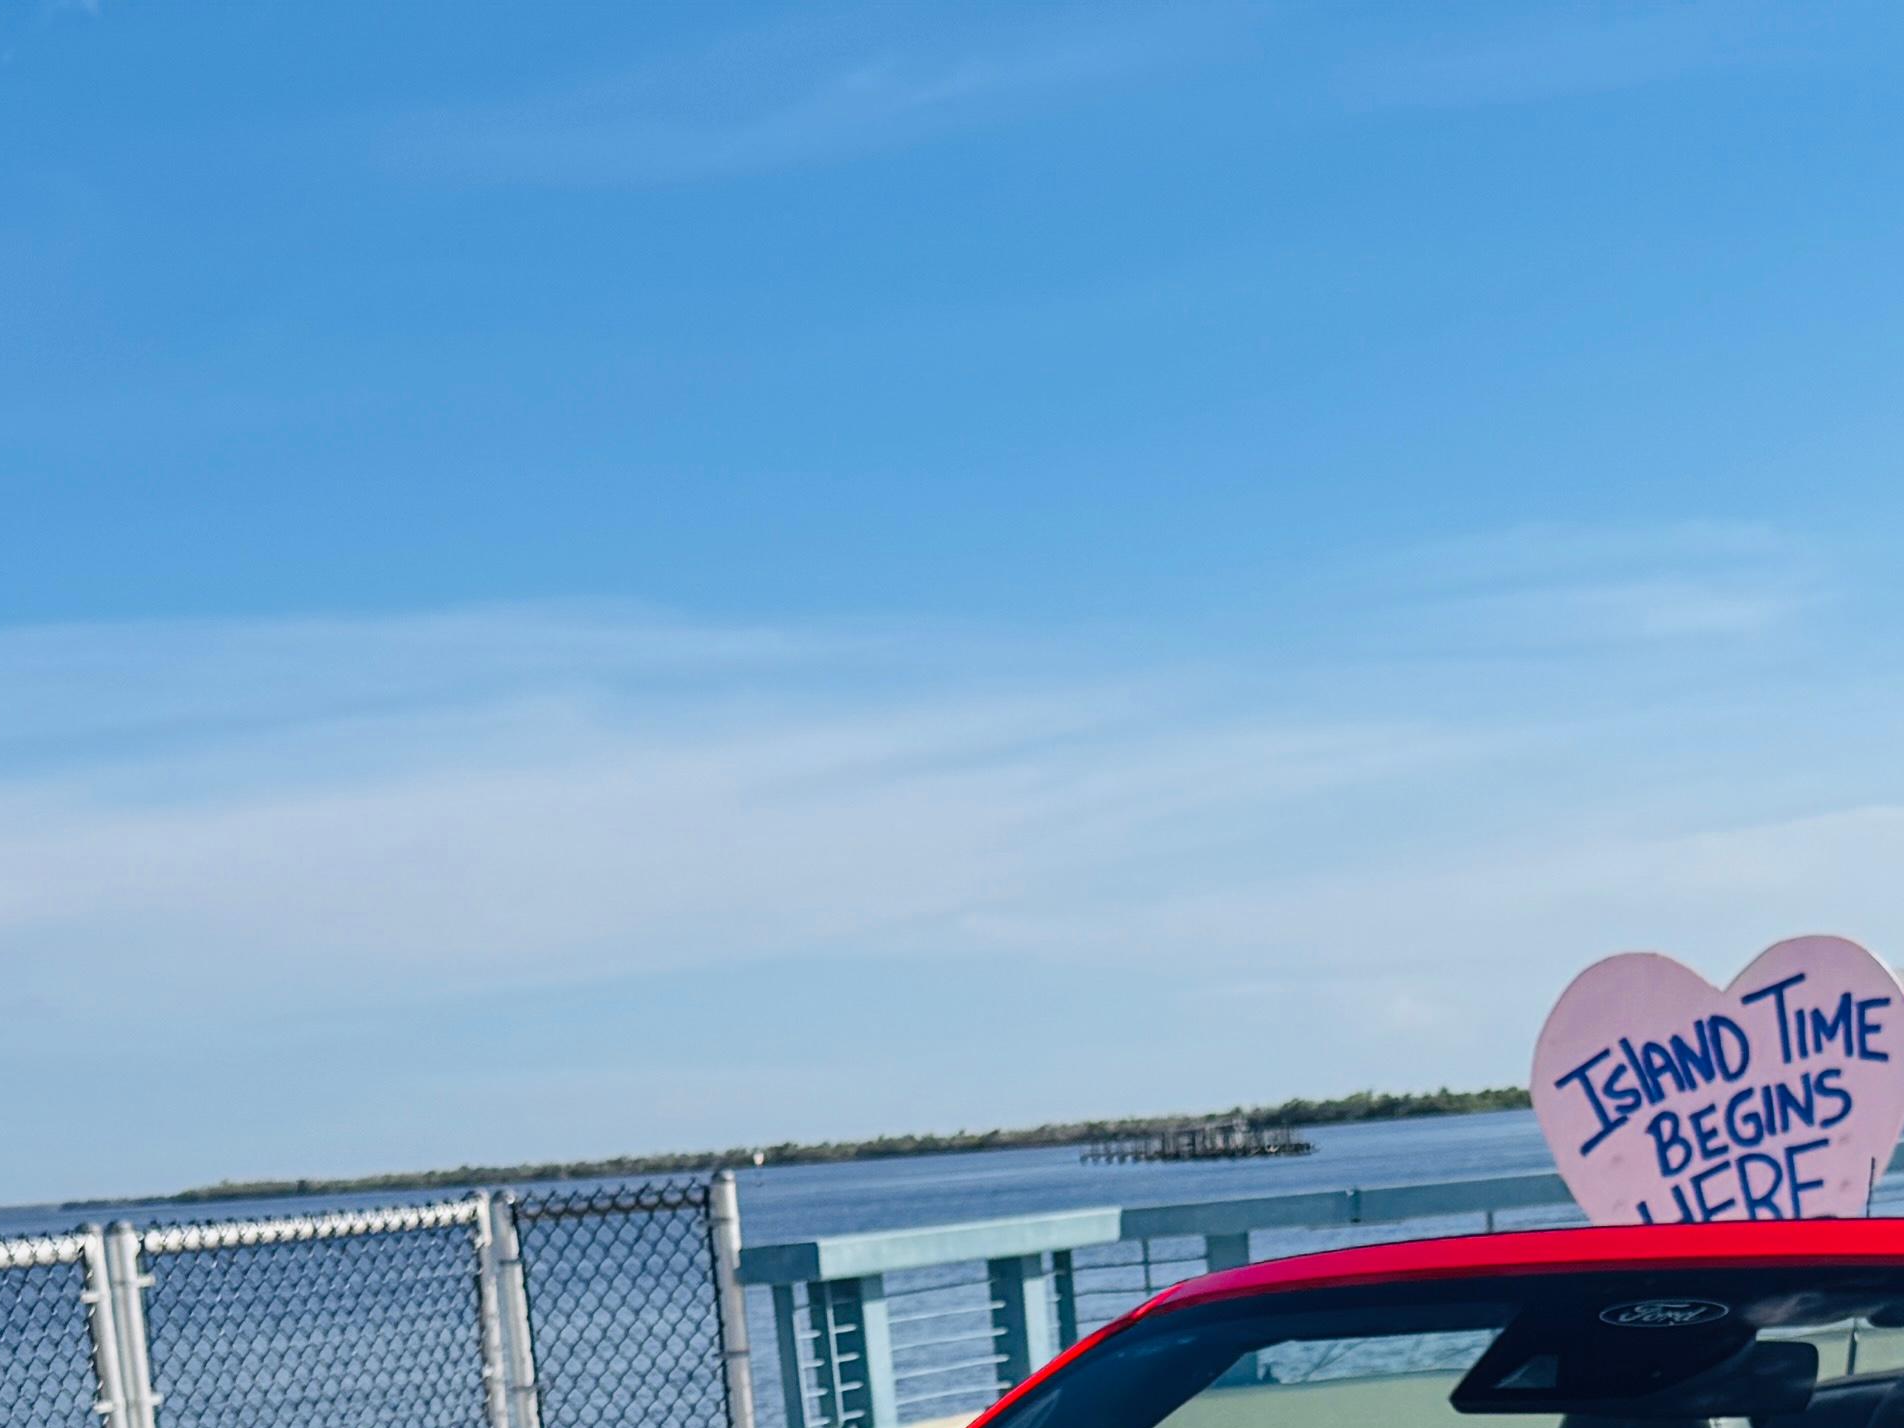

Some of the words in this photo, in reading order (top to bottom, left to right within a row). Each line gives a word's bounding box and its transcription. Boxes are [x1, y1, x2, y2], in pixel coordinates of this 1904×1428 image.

[1741, 972, 1892, 1064] TIME
[1645, 1068, 1853, 1178] BEGINS
[1618, 1303, 1708, 1323] Ford
